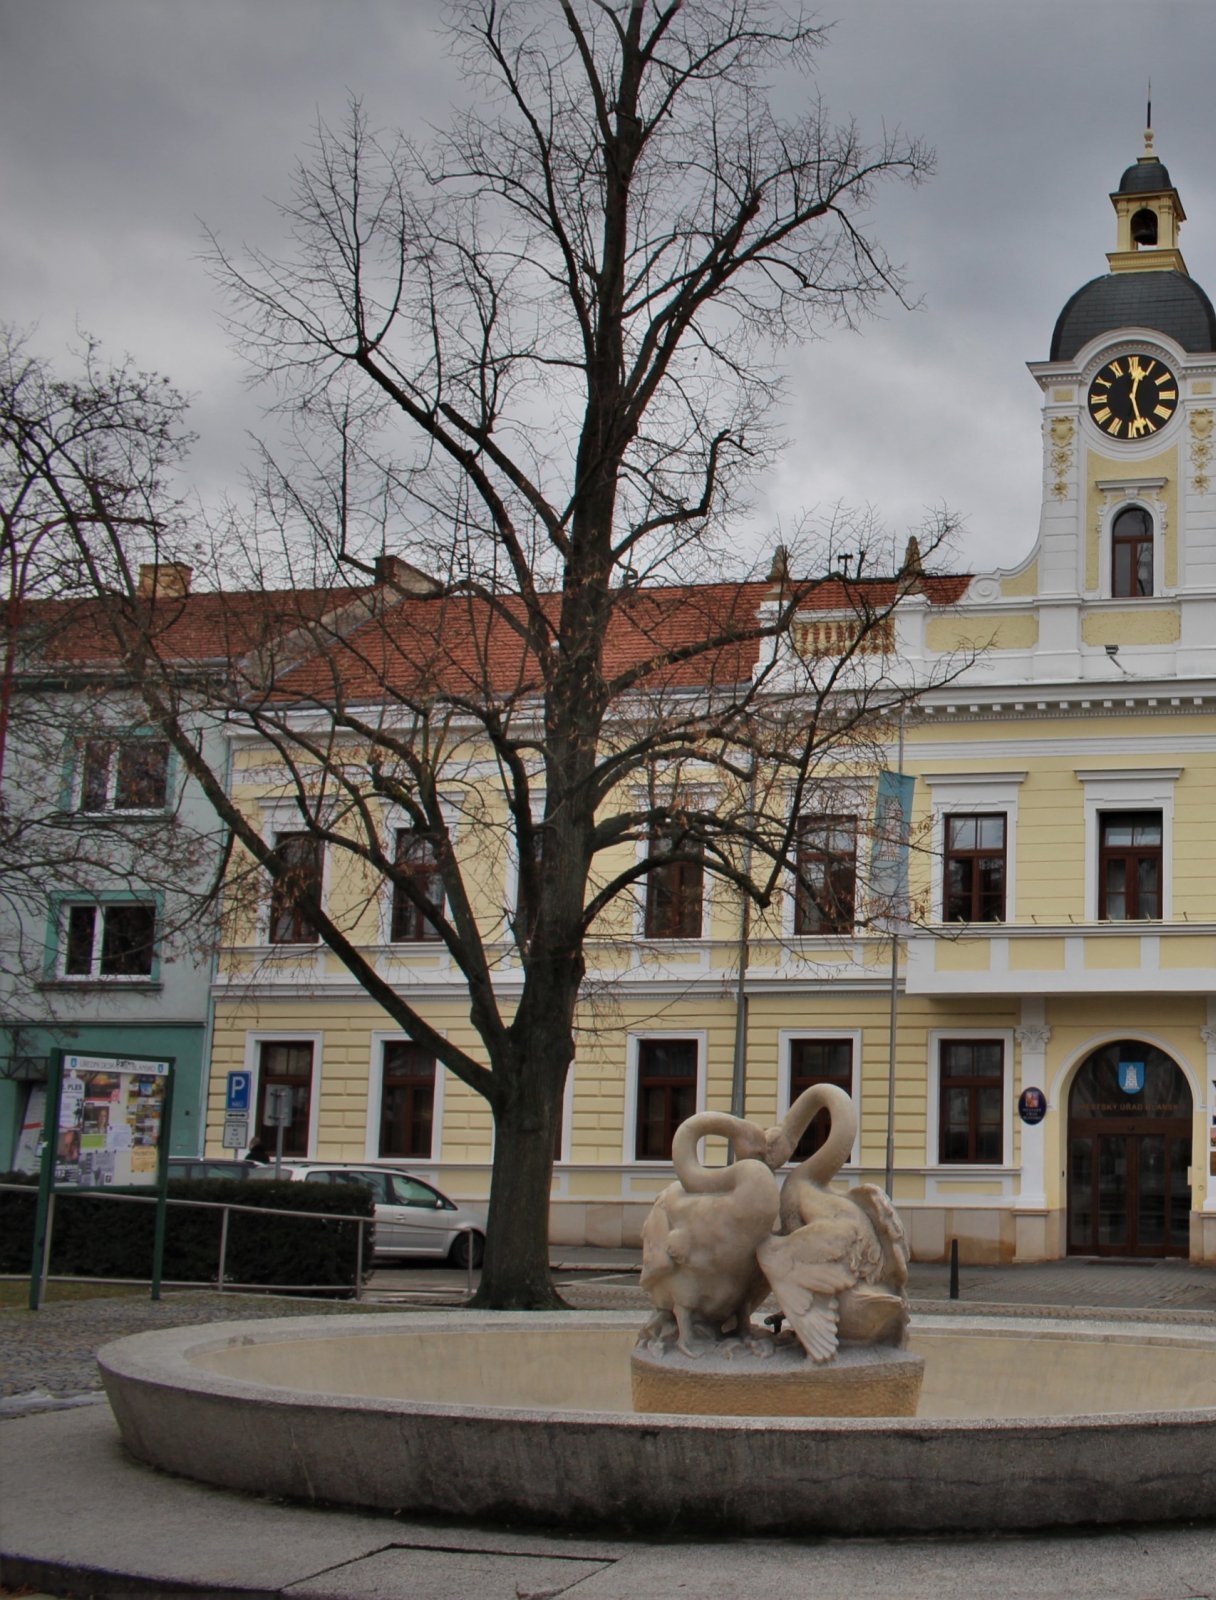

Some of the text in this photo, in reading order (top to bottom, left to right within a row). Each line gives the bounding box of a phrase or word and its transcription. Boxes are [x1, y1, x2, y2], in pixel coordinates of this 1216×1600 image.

[1108, 361, 1124, 379] XI
[1095, 376, 1113, 389] X
[1154, 372, 1172, 386] II
[1090, 394, 1108, 404] IX
[1158, 390, 1176, 400] III
[231, 1076, 246, 1099] P
